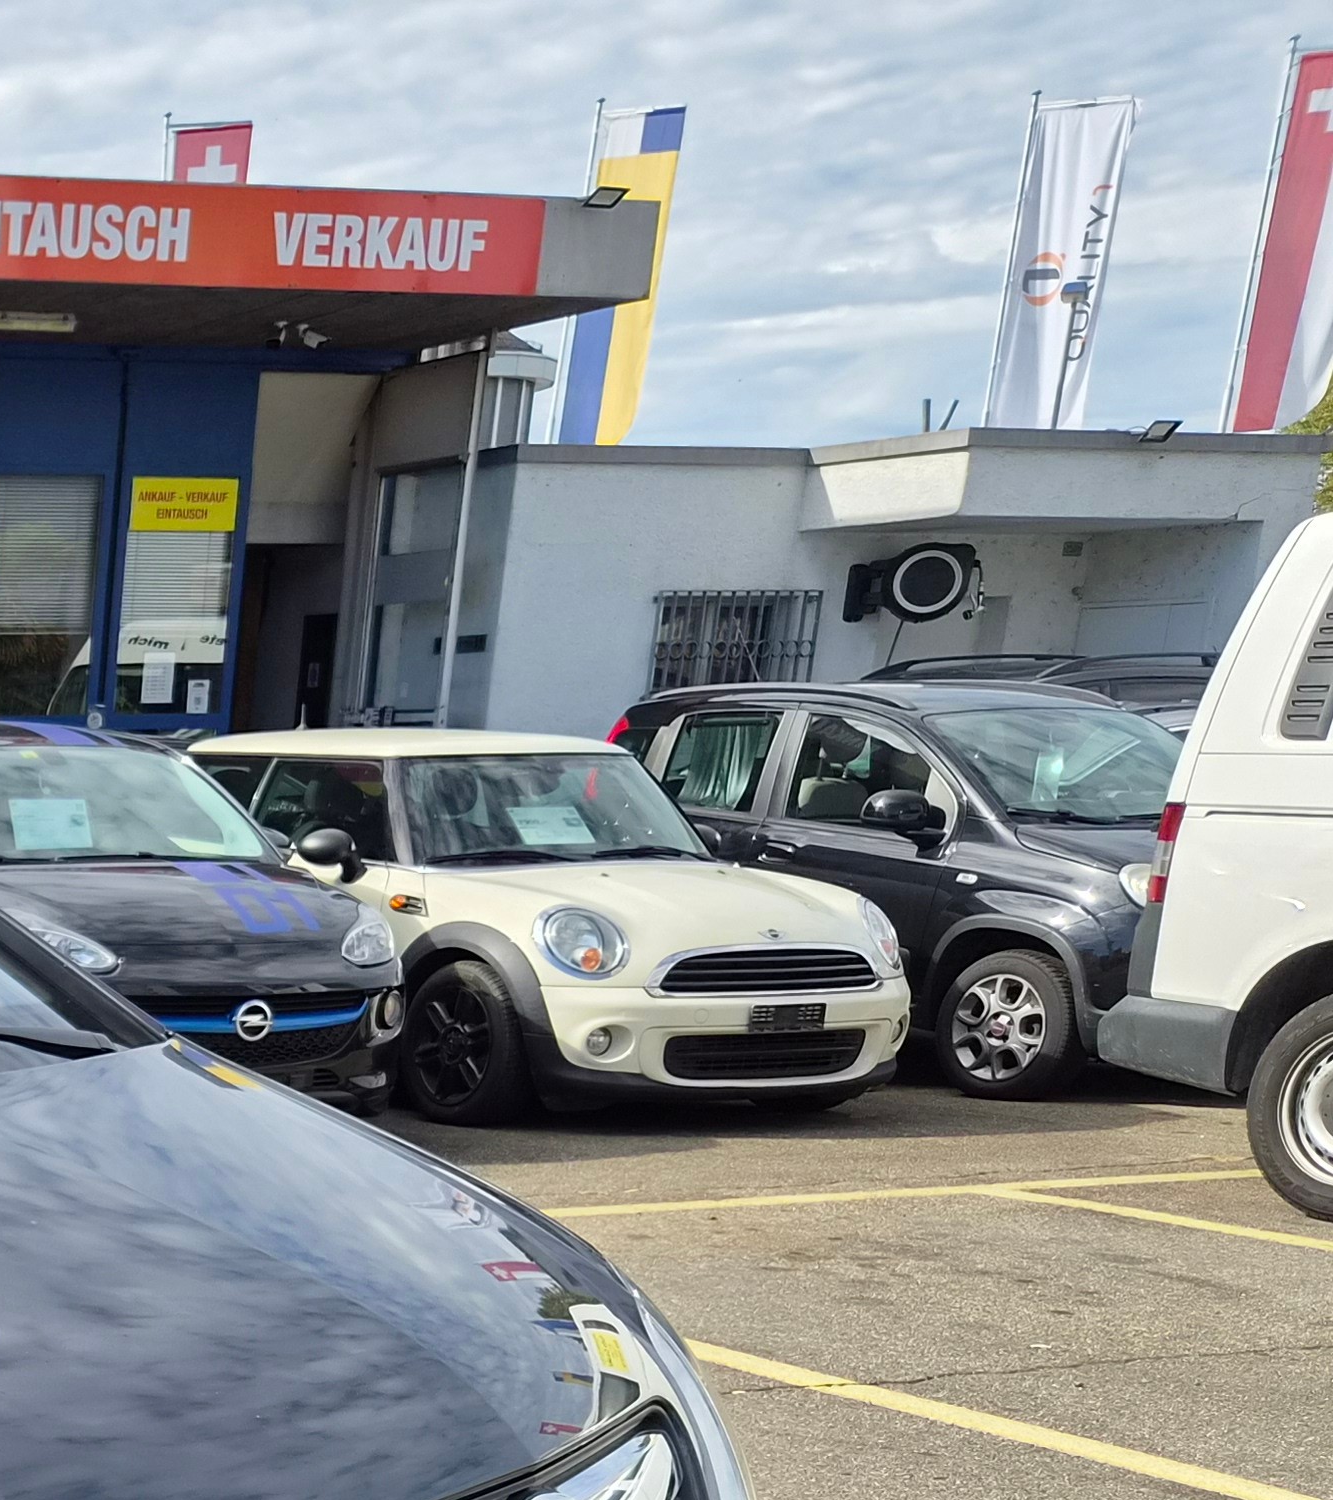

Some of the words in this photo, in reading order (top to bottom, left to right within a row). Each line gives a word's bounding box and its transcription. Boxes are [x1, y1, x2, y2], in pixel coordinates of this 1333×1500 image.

[273, 210, 489, 273] VERKAUF
[138, 491, 177, 503] ANKAUF
[185, 491, 230, 503] VERKAUF
[156, 508, 209, 520] EINTAUSCH
